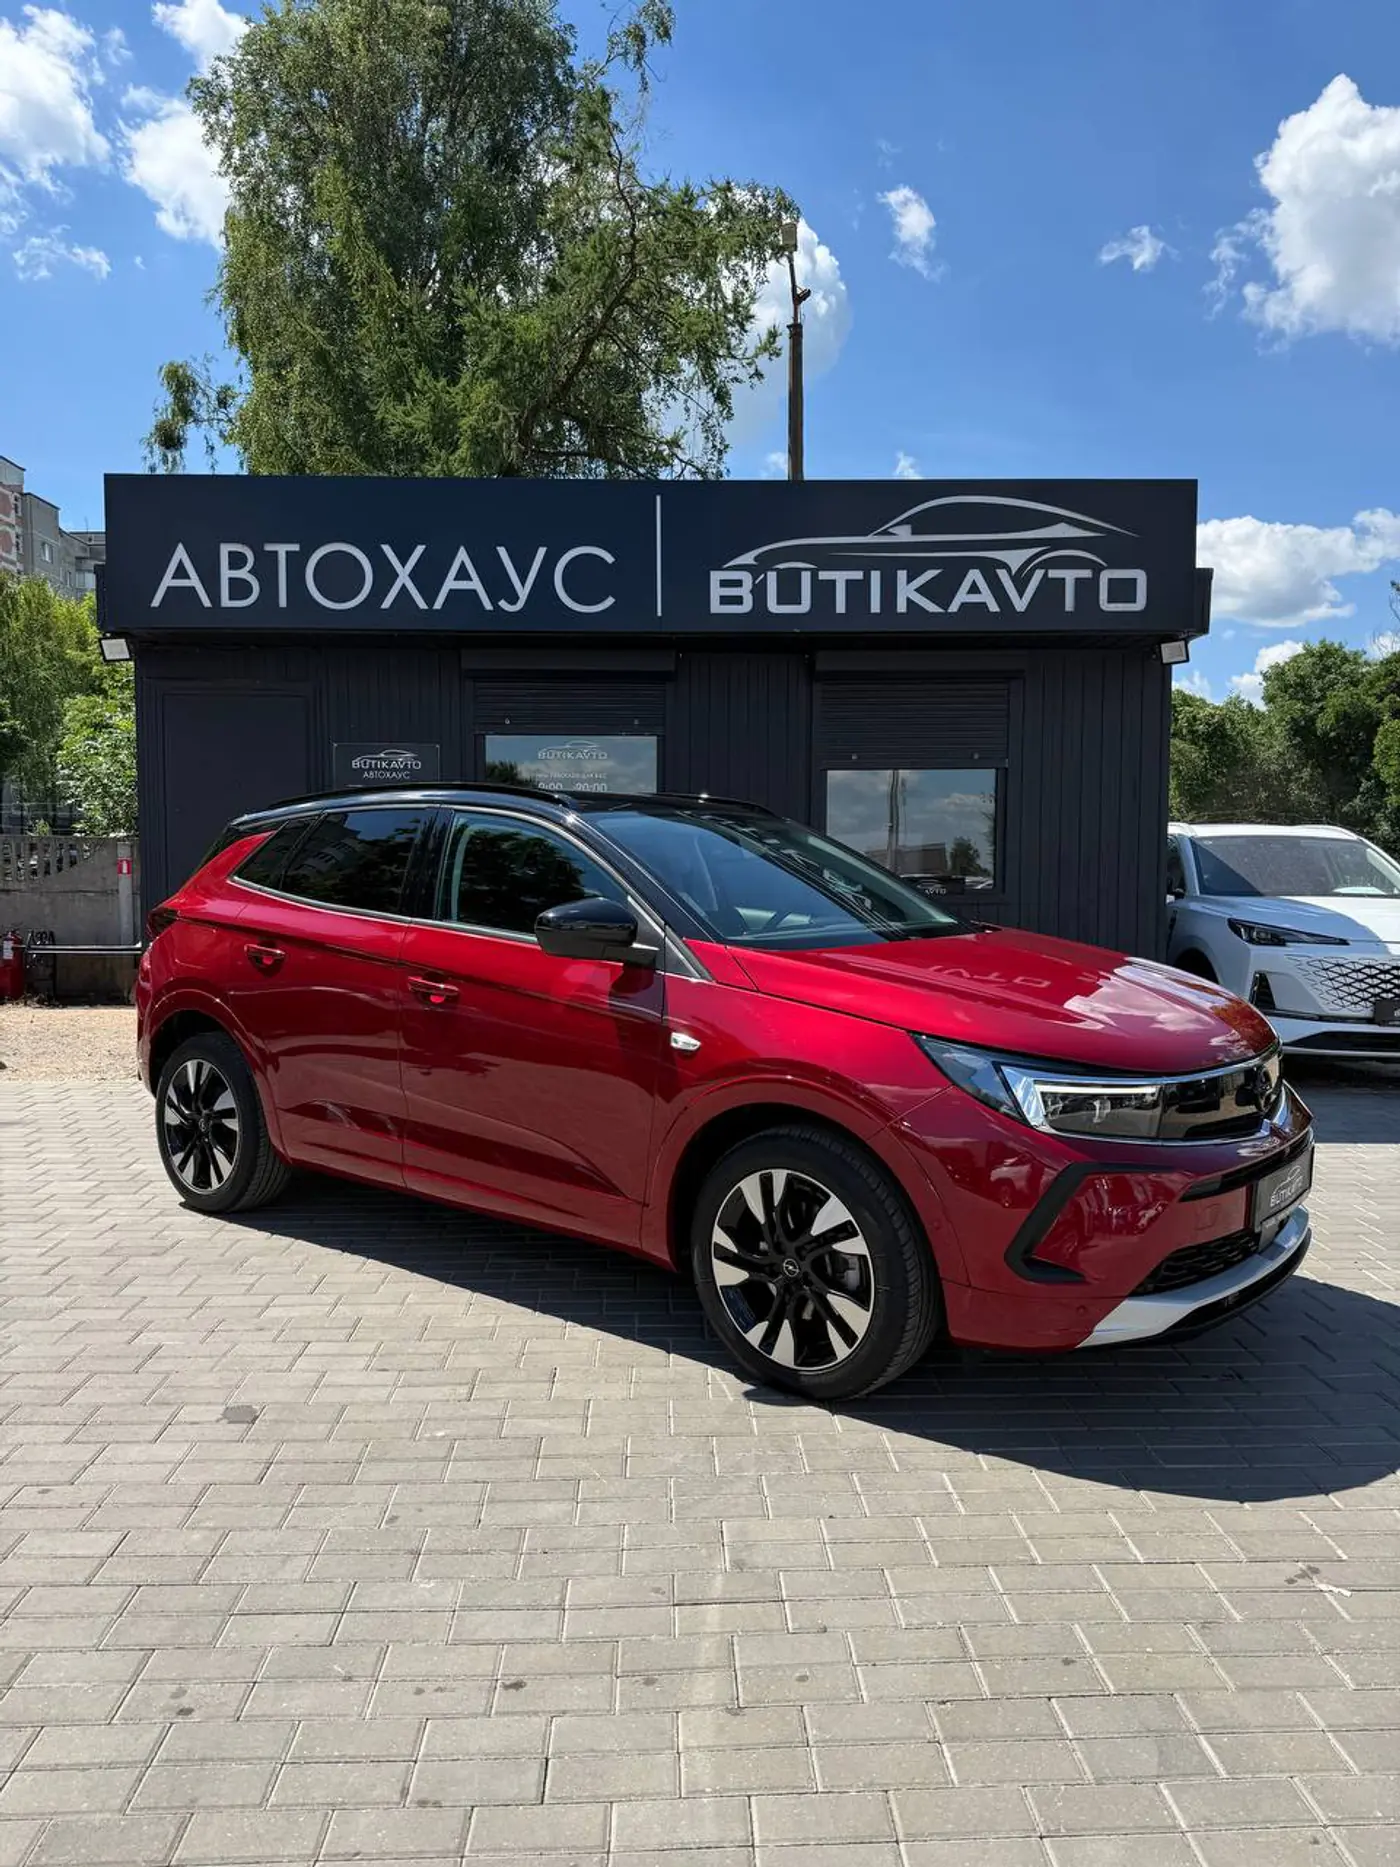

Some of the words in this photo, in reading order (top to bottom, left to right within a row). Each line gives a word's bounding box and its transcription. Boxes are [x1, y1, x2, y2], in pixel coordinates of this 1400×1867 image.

[150, 541, 616, 613] АВТОХАУС
[709, 568, 1147, 614] BUTIKAVTO
[351, 759, 422, 770] BUTIKAVTO
[363, 771, 410, 780] АВТОХАУС
